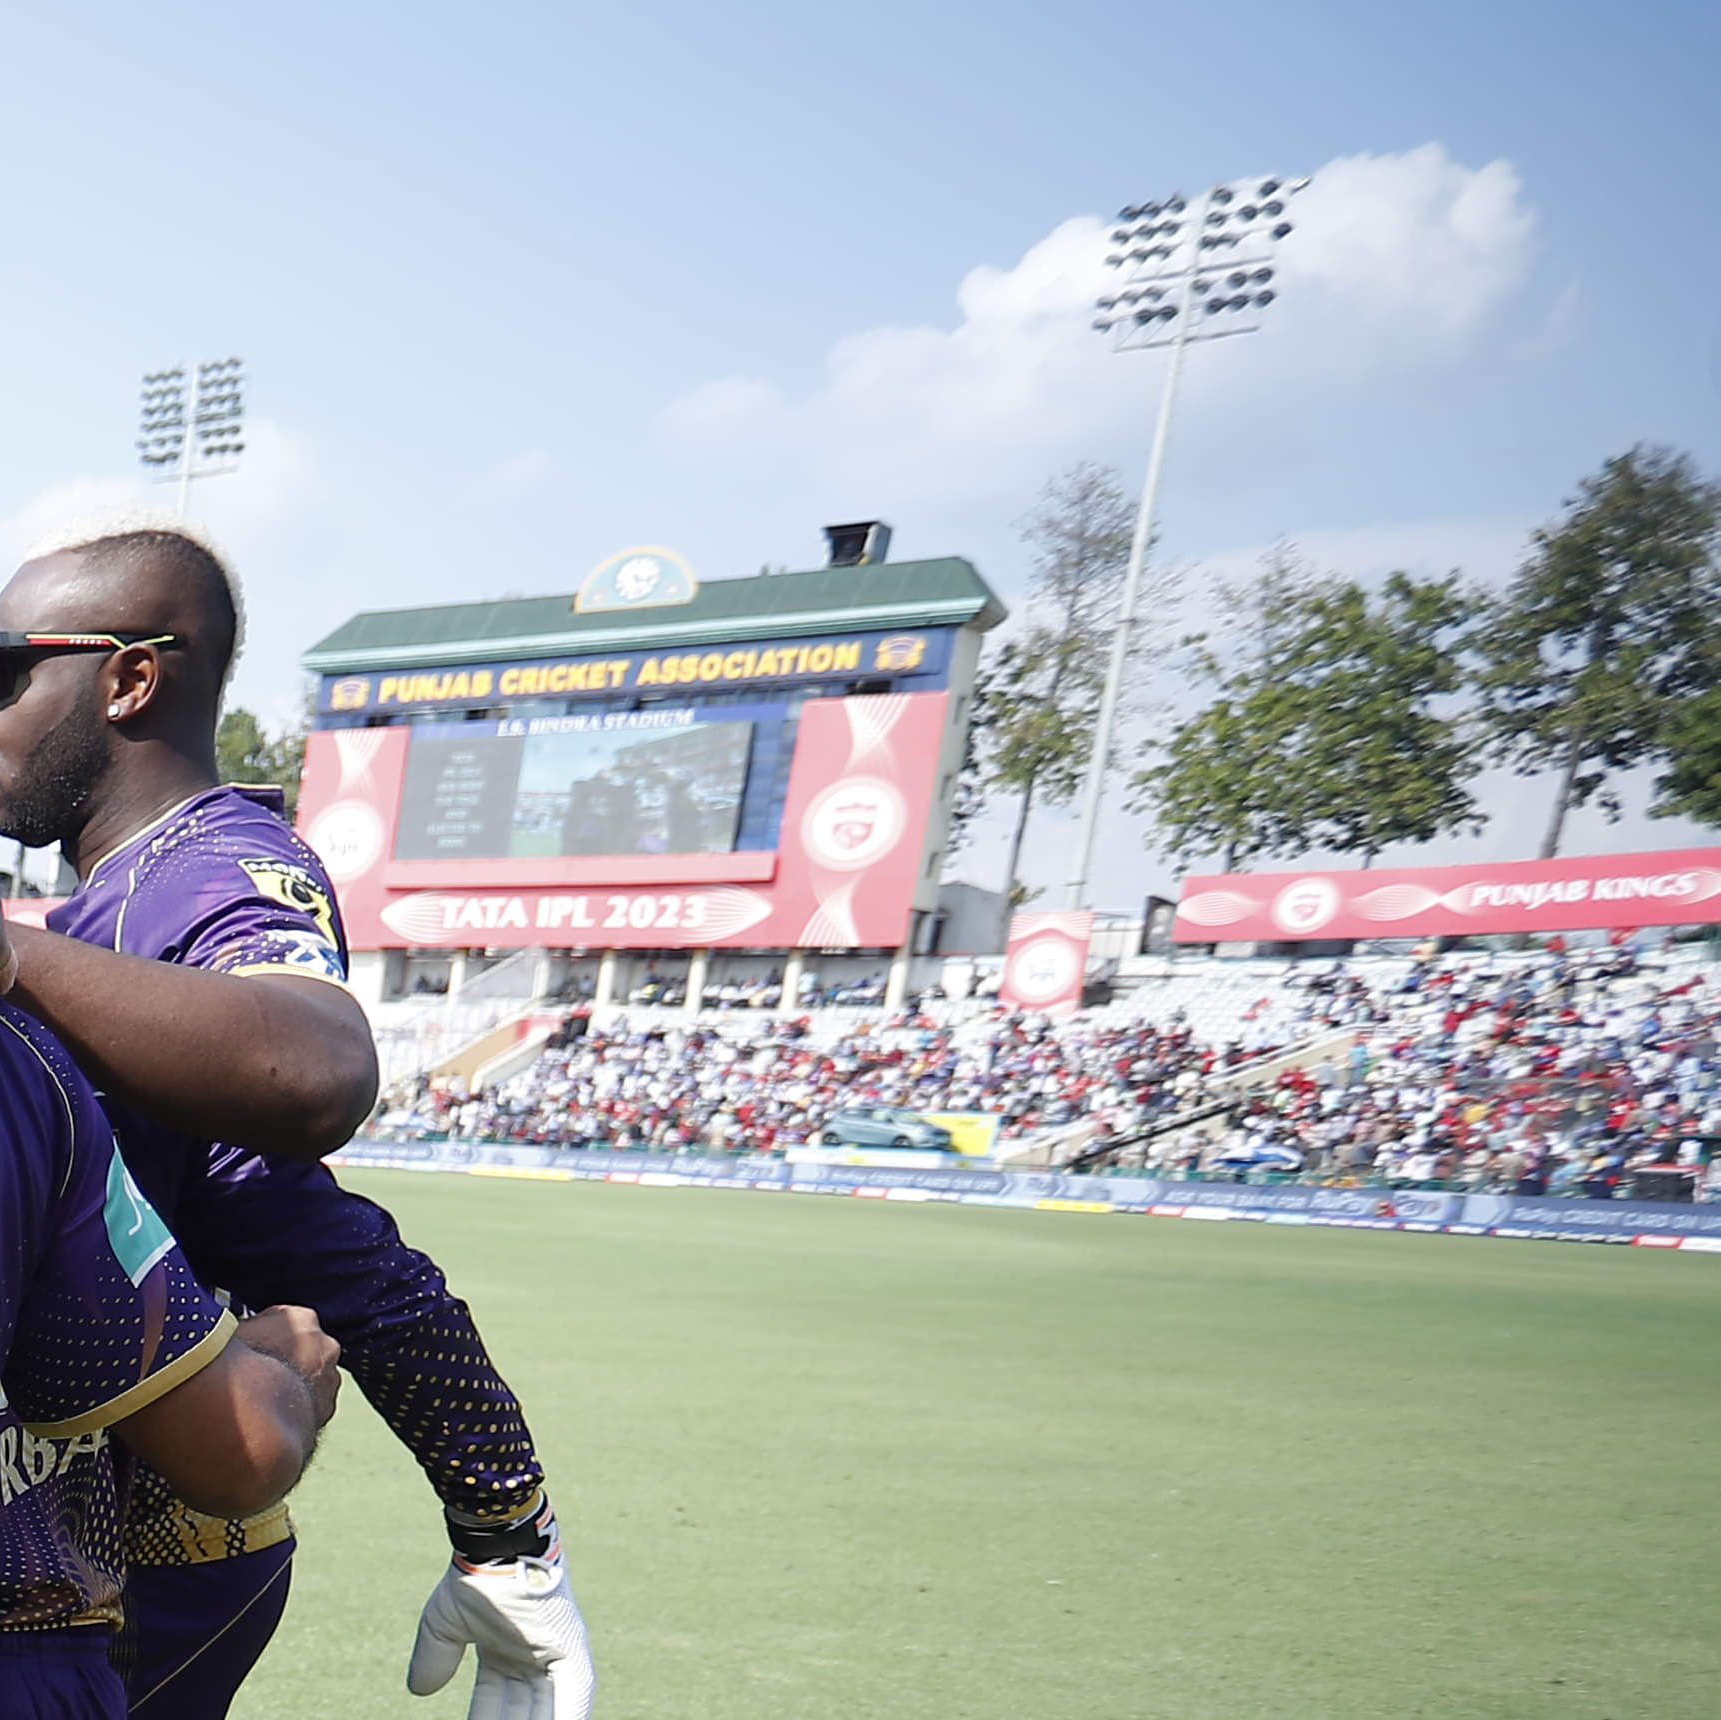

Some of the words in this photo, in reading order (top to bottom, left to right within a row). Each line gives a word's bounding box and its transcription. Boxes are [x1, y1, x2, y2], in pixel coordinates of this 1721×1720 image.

[378, 670, 493, 703] PUNJAB
[499, 659, 631, 696] CRICKET
[636, 641, 862, 685] ASSOCIATION
[603, 708, 695, 731] STADIUM
[1471, 879, 1591, 910] PUNJAB
[1592, 871, 1700, 900] KINGS
[439, 895, 528, 929] TATA
[535, 895, 594, 929] IPL
[603, 894, 706, 929] 2023
